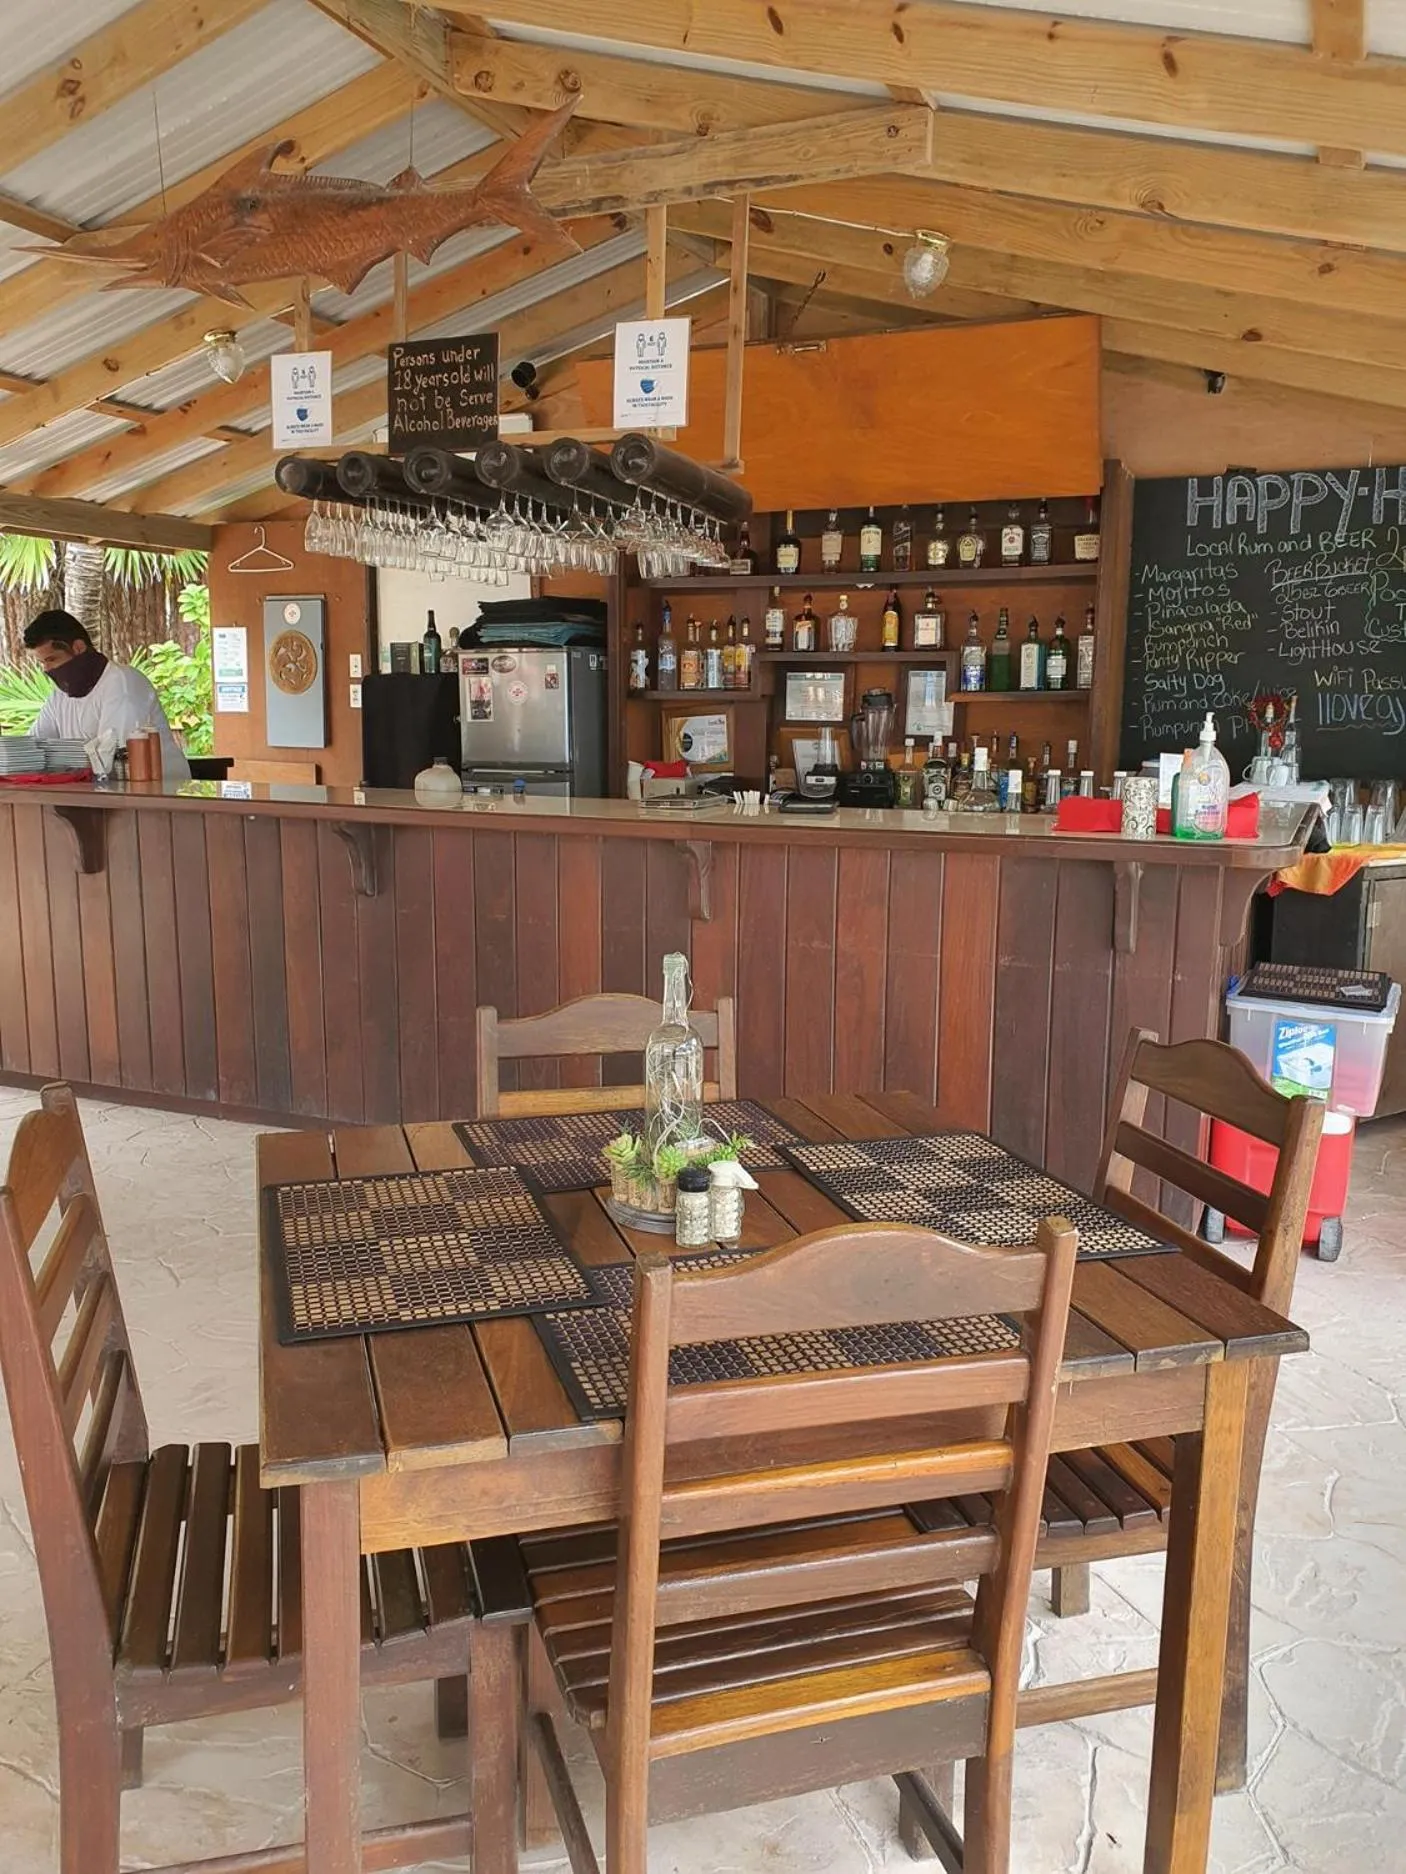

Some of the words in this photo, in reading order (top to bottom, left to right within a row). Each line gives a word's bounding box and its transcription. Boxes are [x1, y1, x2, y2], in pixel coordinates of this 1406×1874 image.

[393, 347, 435, 368] Persons
[441, 344, 480, 362] under
[393, 369, 411, 391] 18
[474, 362, 494, 381] will
[397, 393, 426, 413] not
[434, 389, 451, 409] be
[460, 389, 493, 407] Serve
[393, 411, 444, 434] Alcohol
[1238, 532, 1273, 555] Rum
[1277, 533, 1312, 552] and
[1280, 599, 1337, 622] Stout
[1193, 672, 1226, 696] Dog
